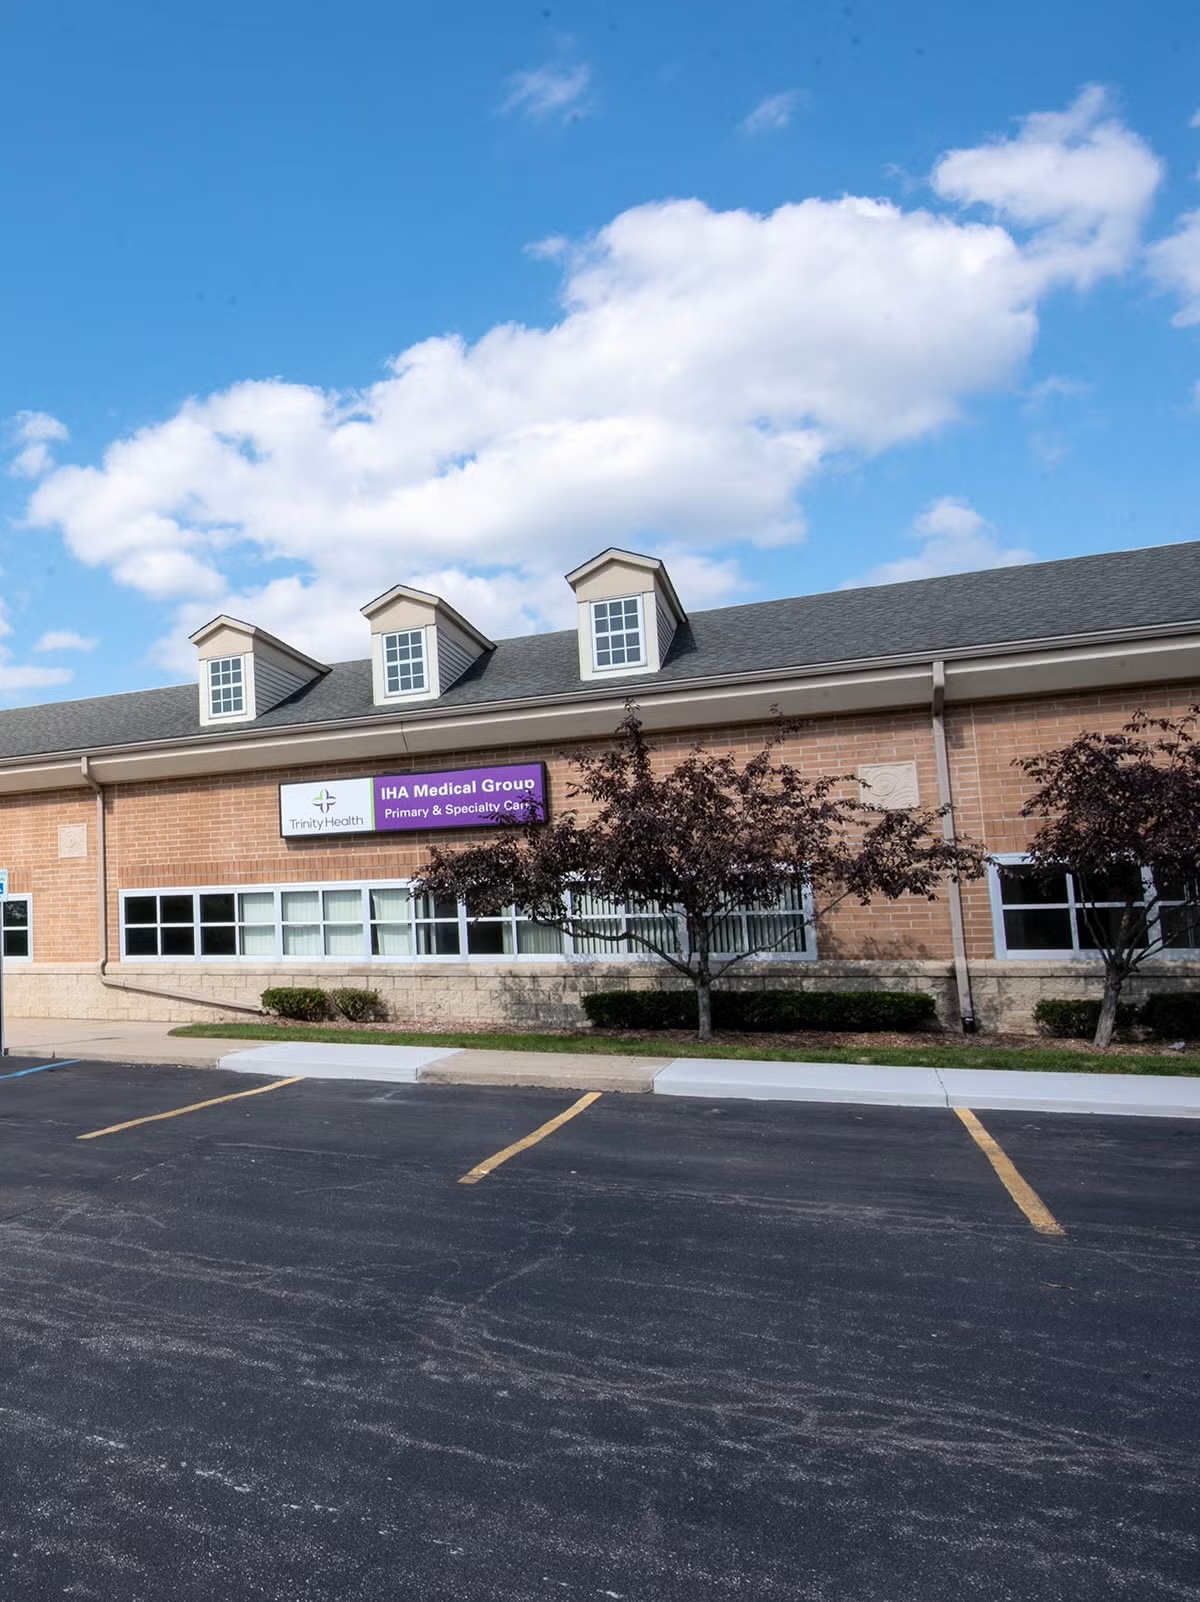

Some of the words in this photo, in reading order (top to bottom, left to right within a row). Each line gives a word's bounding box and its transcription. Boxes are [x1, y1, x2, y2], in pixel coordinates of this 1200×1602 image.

[381, 786, 409, 801] IHA
[414, 780, 477, 798] Medical
[481, 778, 535, 793] Group
[385, 807, 429, 819] Primary
[432, 805, 442, 815] &
[445, 802, 500, 816] Specialty
[289, 818, 324, 830] Trinity
[325, 816, 364, 827] Health
